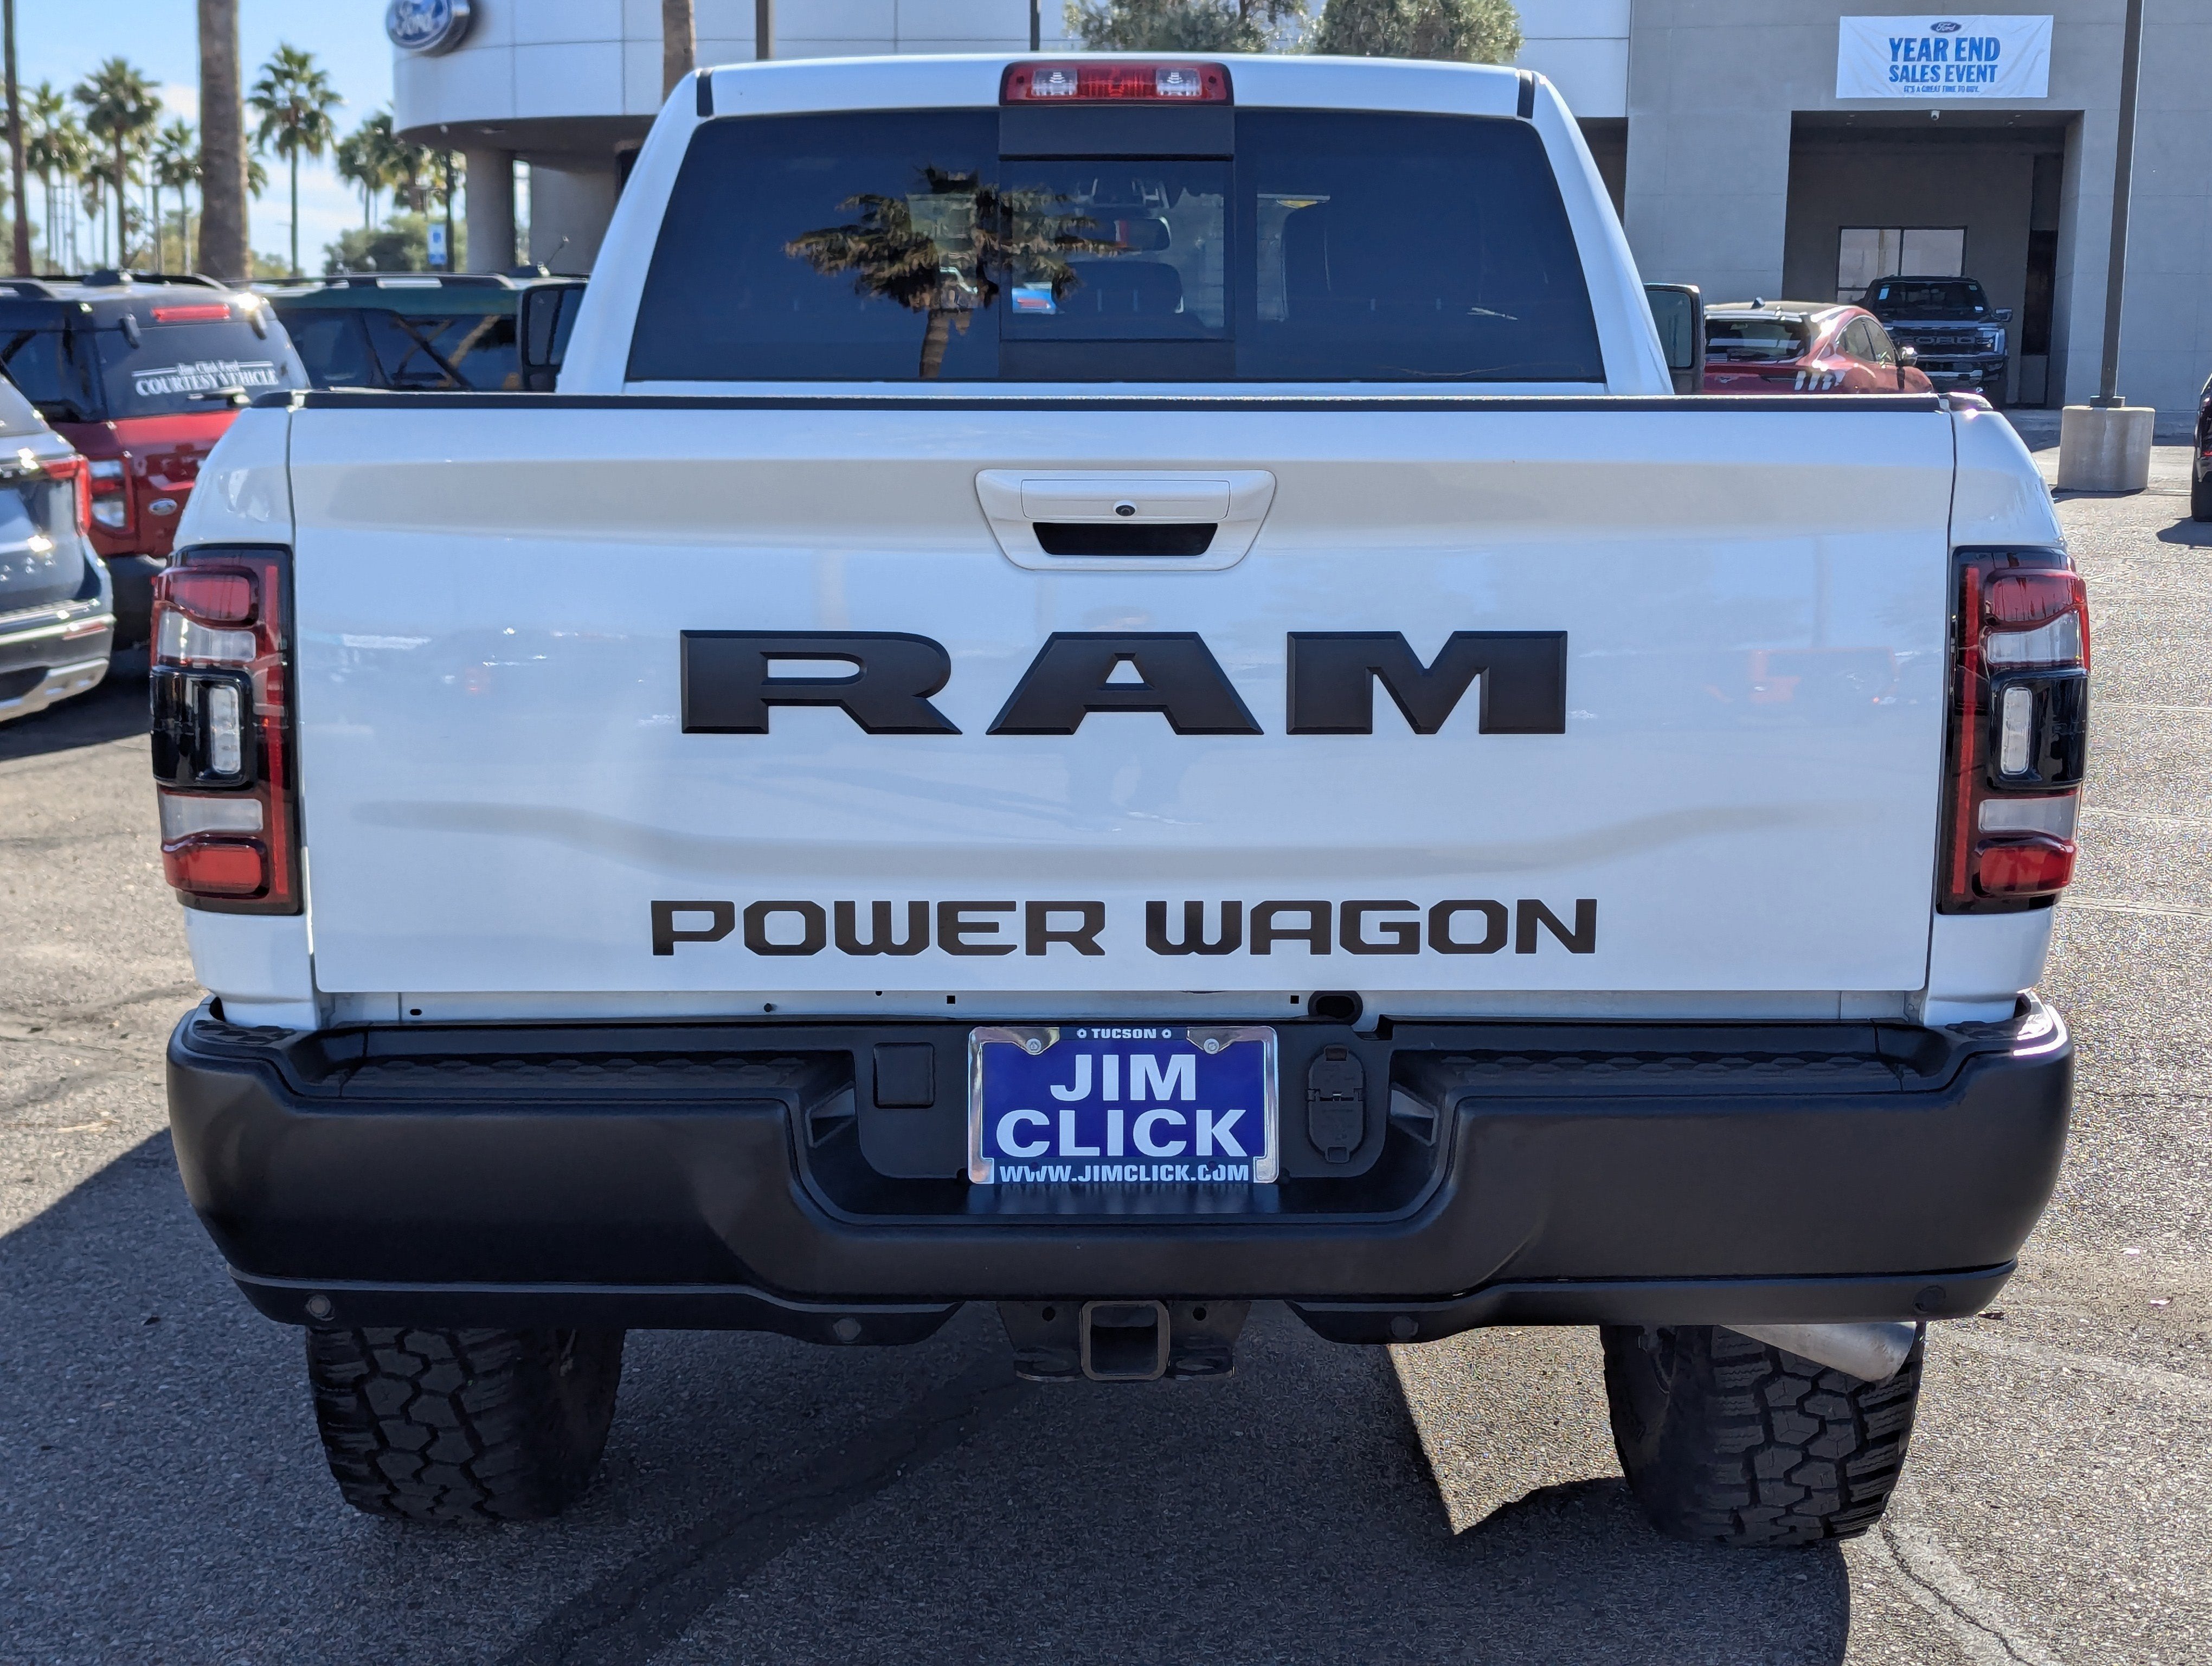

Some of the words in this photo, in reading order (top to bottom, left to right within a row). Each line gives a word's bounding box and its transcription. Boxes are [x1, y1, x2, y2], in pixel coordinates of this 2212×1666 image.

[1889, 37, 1949, 62] YEAR
[1954, 37, 2001, 62] END
[1889, 65, 1941, 82] SALES
[1945, 65, 1998, 82] EVENT
[136, 372, 218, 396] COURTESY
[680, 630, 1567, 735] RAM
[651, 900, 1105, 956] POWER
[1146, 898, 1597, 956] WAGON
[1091, 1028, 1156, 1039] TUCSON
[1050, 1054, 1196, 1101] JIM
[996, 1108, 1248, 1157] CLICK
[999, 1164, 1249, 1183] WWW.JIMCLICK.COM
